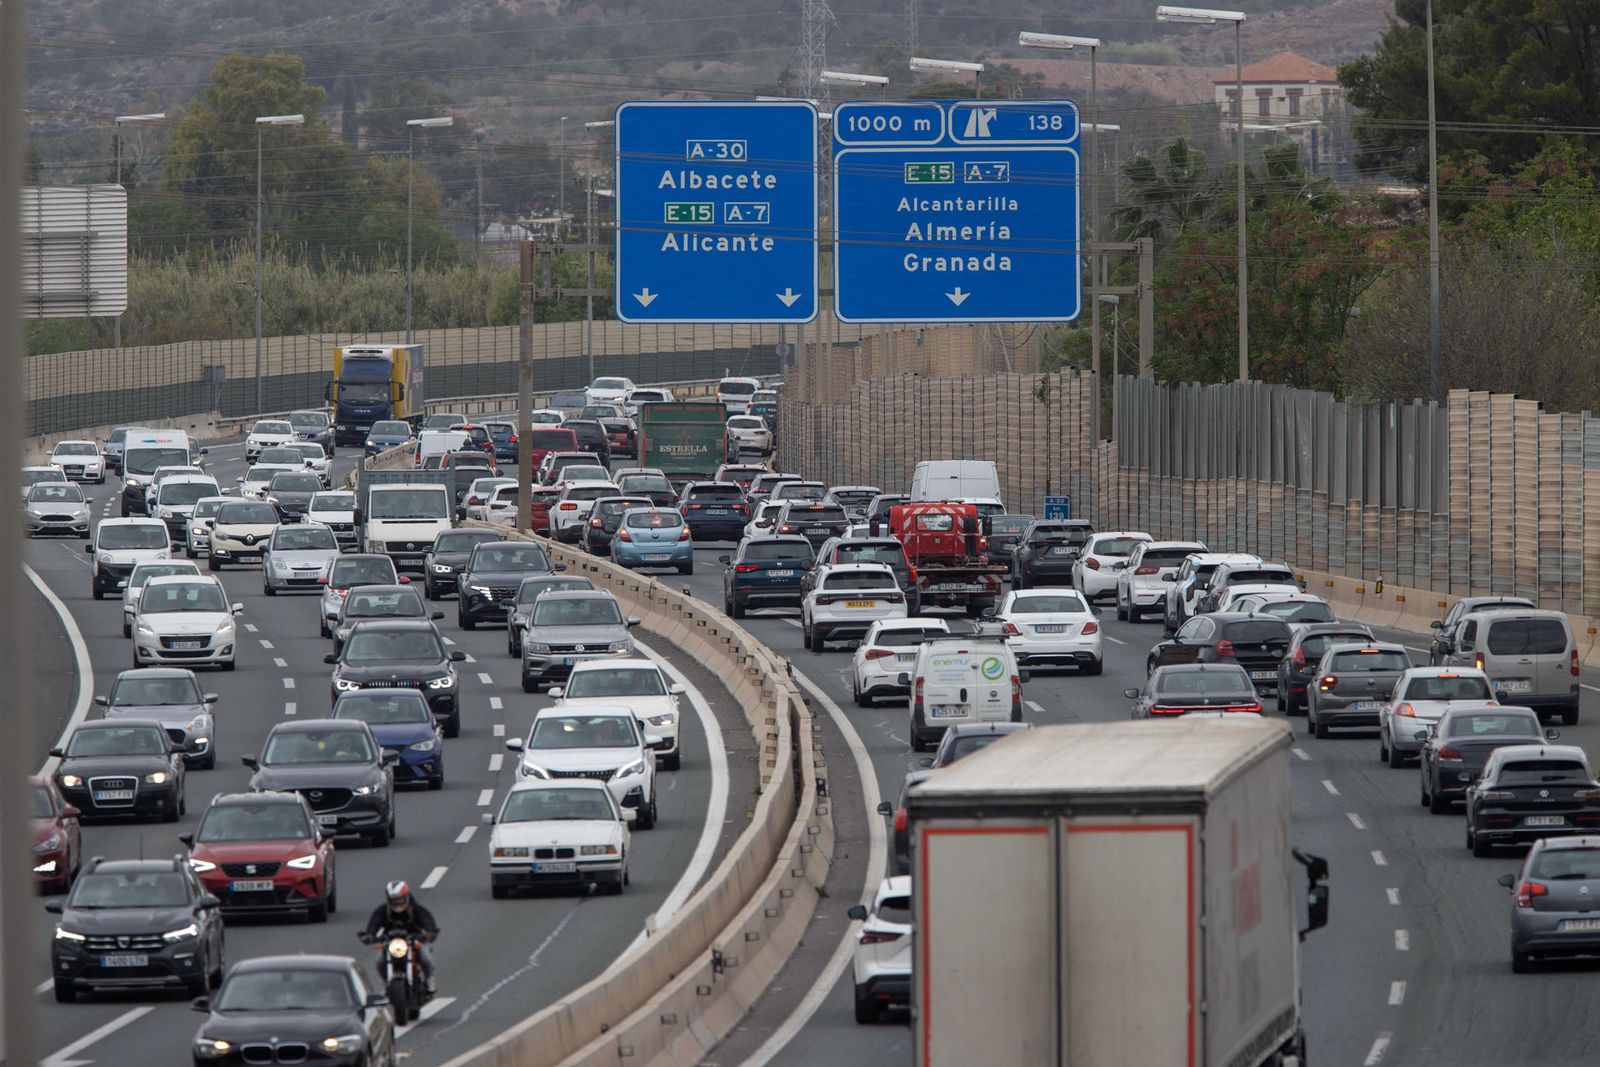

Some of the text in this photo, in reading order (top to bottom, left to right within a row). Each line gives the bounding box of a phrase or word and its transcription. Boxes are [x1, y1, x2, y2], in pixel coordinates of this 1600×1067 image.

[848, 116, 931, 132] 1000 m
[1029, 115, 1063, 131] 138
[690, 143, 744, 159] A-30
[658, 170, 777, 189] Albacete
[907, 165, 1007, 181] E-15 A-7
[897, 197, 1019, 212] Alcantarilla
[667, 206, 767, 221] E-15 A-7
[905, 221, 1011, 241] Almería
[661, 233, 774, 252] Alicante
[903, 252, 1012, 272] Granada
[659, 445, 708, 453] ESTRELLA
